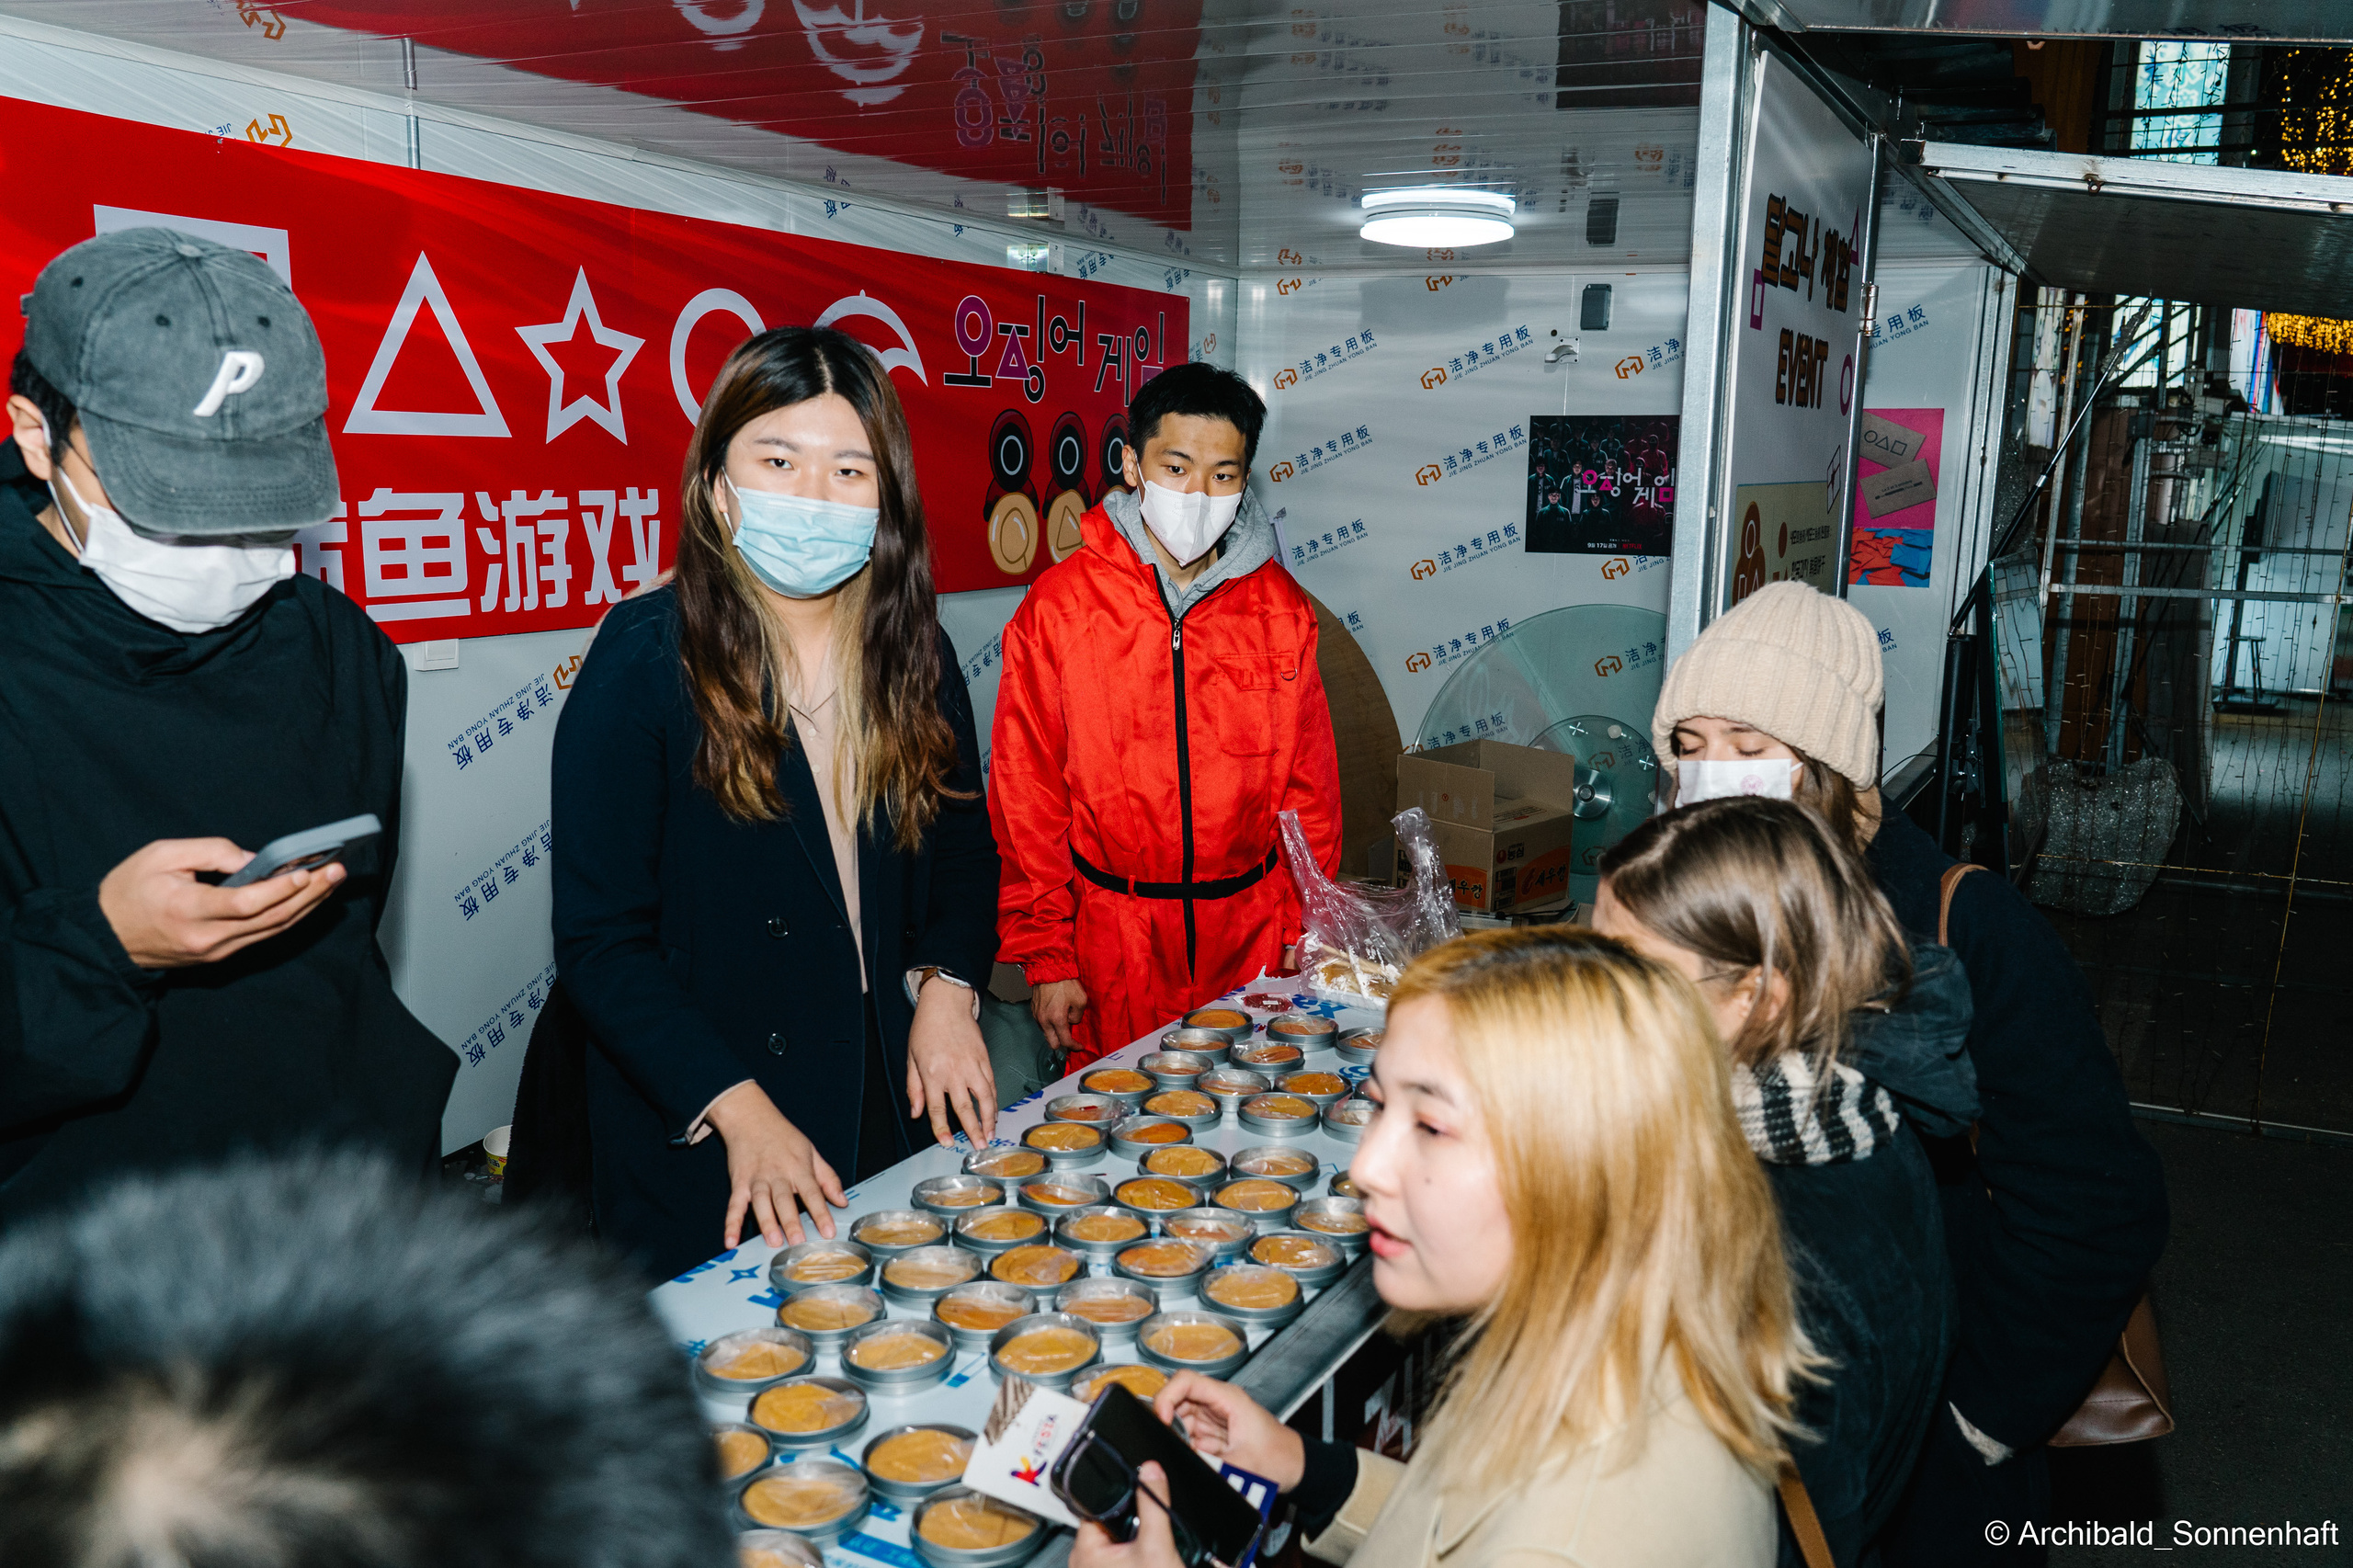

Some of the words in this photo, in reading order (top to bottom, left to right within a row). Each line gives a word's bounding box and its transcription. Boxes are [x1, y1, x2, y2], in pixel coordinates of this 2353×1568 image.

[216, 122, 232, 137] JIE
[1761, 193, 1819, 302] 달고나
[1890, 328, 1912, 341] YONG
[1913, 320, 1929, 331] BAN
[943, 294, 1086, 403] 오징어
[1094, 312, 1165, 407] 게임
[1299, 328, 1375, 375] 洁净专用板
[1314, 368, 1327, 377] JING
[1328, 358, 1347, 370] ZHUAN
[1347, 349, 1364, 359] YONG
[1365, 343, 1378, 351] BAN
[1449, 324, 1530, 373] 洁净专用板
[1453, 372, 1463, 381] JIE
[1464, 365, 1479, 376] JING
[1479, 355, 1501, 369] ZHUAN
[1501, 346, 1519, 358] YONG
[1520, 339, 1533, 348] BAN
[1653, 362, 1662, 370] JIE
[1665, 354, 1679, 365] JING
[1775, 327, 1829, 410] EVENT
[193, 350, 266, 417] P
[1295, 424, 1370, 469] 洁净专用板
[1310, 460, 1324, 471] JING
[1324, 451, 1343, 464] ZHUAN
[1343, 443, 1360, 454] YONG
[1360, 438, 1373, 448] BAN
[1442, 424, 1525, 471] 洁净专用板
[1448, 470, 1458, 478] JIE
[1459, 463, 1472, 473] JING
[1473, 453, 1495, 466] ZHUAN
[1495, 445, 1513, 456] YONG
[1514, 438, 1528, 449] BAN
[1578, 467, 1643, 497] 오징어
[1631, 467, 1676, 508] 게임
[1291, 517, 1366, 560] 洁净专用板
[1297, 559, 1305, 567] JIE
[1306, 553, 1319, 562] JING
[1320, 544, 1338, 557] ZHUAN
[1338, 538, 1356, 548] YONG
[1356, 531, 1369, 541] BAN
[1437, 521, 1518, 566] 洁净专用板
[1442, 564, 1452, 574] JIE
[1452, 559, 1468, 569] JING
[1468, 550, 1489, 562] ZHUAN
[1489, 541, 1507, 553] YONG
[1507, 536, 1521, 546] BAN
[1637, 563, 1648, 573] JIE
[1649, 558, 1665, 568] JING
[1351, 624, 1364, 632] BAN
[1432, 618, 1509, 660] 洁净专用板
[1438, 658, 1448, 666] JIE
[1448, 653, 1462, 663] JING
[1631, 662, 1641, 671] JIE
[515, 682, 532, 699] JING
[533, 673, 545, 687] JIE
[488, 696, 516, 720] ZHUAN
[451, 683, 553, 770] 洁净专用板
[465, 717, 488, 737] YONG
[1495, 725, 1508, 734] BAN
[447, 733, 465, 751] BAN
[520, 829, 538, 846] JING
[539, 819, 551, 832] JIE
[494, 844, 521, 869] ZHUAN
[472, 867, 494, 888] YONG
[454, 885, 472, 903] BAN
[544, 961, 555, 975] JIE
[526, 972, 543, 991] JING
[501, 988, 527, 1014] ZHUAN
[478, 1013, 501, 1034] YONG
[460, 1032, 478, 1051] BAN
